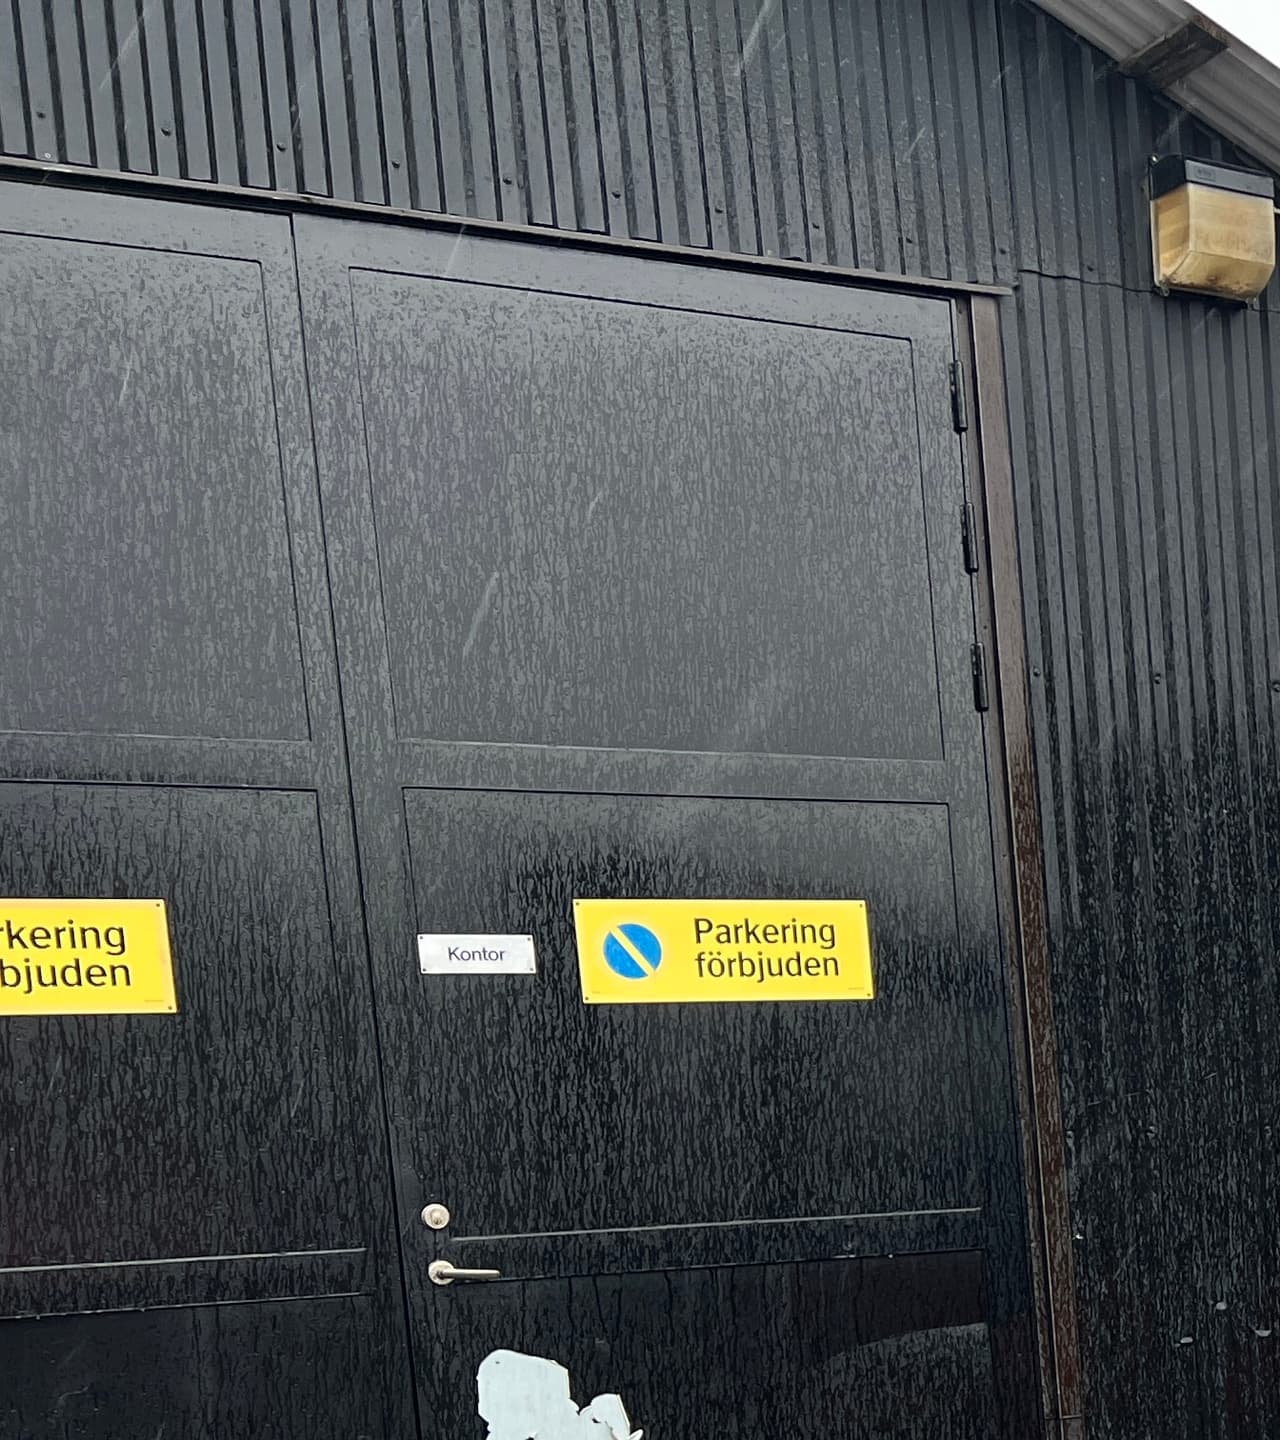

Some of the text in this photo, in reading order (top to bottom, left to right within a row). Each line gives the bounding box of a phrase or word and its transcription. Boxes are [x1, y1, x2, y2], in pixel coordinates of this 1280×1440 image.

[693, 917, 837, 949] Parkering
[447, 945, 507, 962] Kontor
[696, 950, 841, 984] förbjuden
